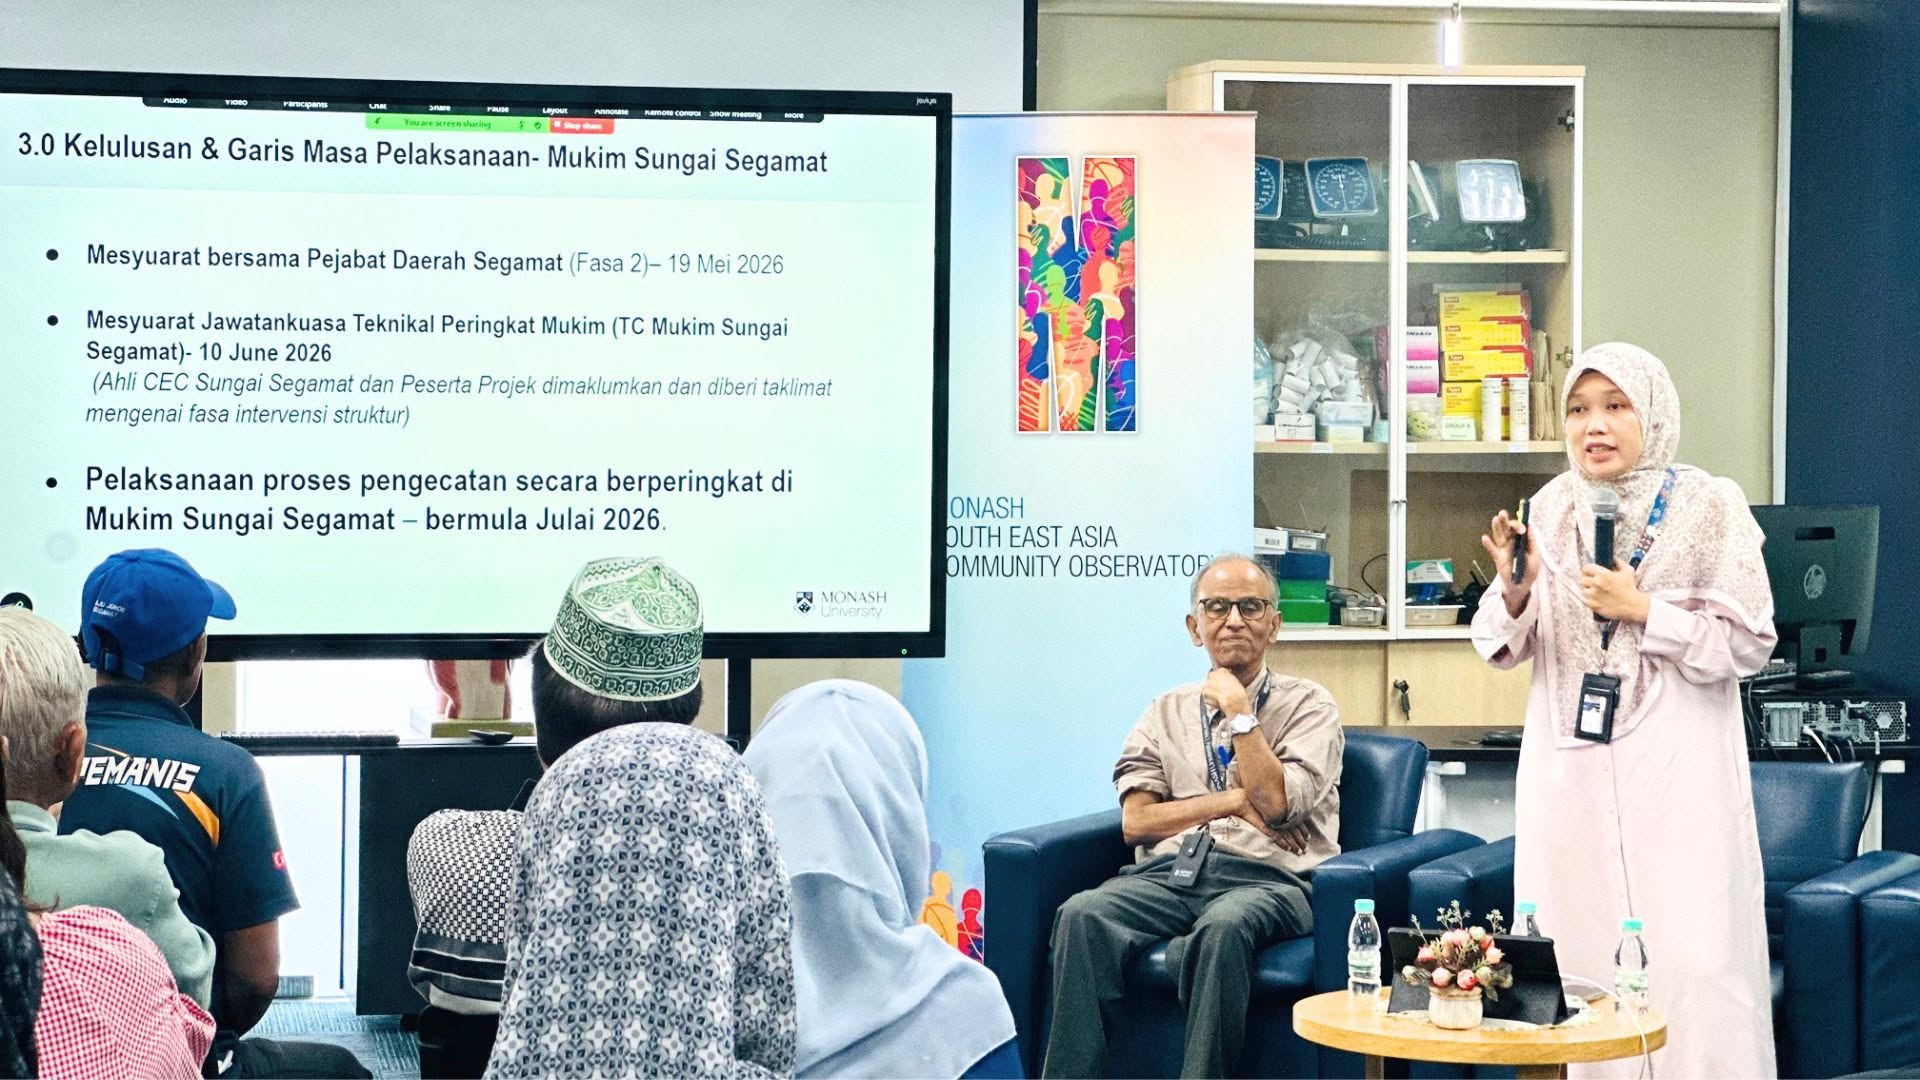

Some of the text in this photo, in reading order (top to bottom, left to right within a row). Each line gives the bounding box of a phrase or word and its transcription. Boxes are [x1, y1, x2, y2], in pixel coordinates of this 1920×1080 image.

[404, 118, 419, 127] You
[462, 120, 492, 130] sharing
[19, 132, 828, 177] 3.0 Kelulusan & Garis Masa Pelaksanaan- Mukim Sungai Segamat
[88, 244, 200, 270] Mesyuarat
[209, 246, 299, 267] bersama
[308, 248, 386, 273] Pejabat
[394, 250, 465, 270] Daerah
[474, 251, 563, 276] Segamat
[569, 252, 624, 277] (Fasa
[669, 254, 690, 273] 19
[698, 254, 730, 274] Mei
[738, 255, 784, 274] 2026
[88, 310, 788, 340] Mesyuarat Jawatankuasa Teknikal Peringkat Mukim (TC Mukim Sungai
[87, 341, 332, 365] Segamat)- 10 June 2026
[93, 371, 832, 398] (Ahli CEC Sungai Segamat dan Peserta Projek dimaklumkan dan diberi taklimat
[86, 404, 410, 428] mengenai fasa intervensi struktur)
[87, 466, 792, 498] Pelaksanaan proses pengecatan secara berperingkat di
[950, 496, 1025, 519] ONASH
[87, 506, 172, 531] Mukim
[183, 506, 272, 536] Sungai
[283, 506, 395, 536] Segamat
[426, 507, 527, 530] bermula
[536, 507, 593, 530] Julai
[946, 525, 1119, 548] OUTH EAST ASIA
[946, 554, 1213, 578] OMMUNITY OBSERVATOR
[821, 591, 887, 604] MONASH
[821, 604, 884, 620] University
